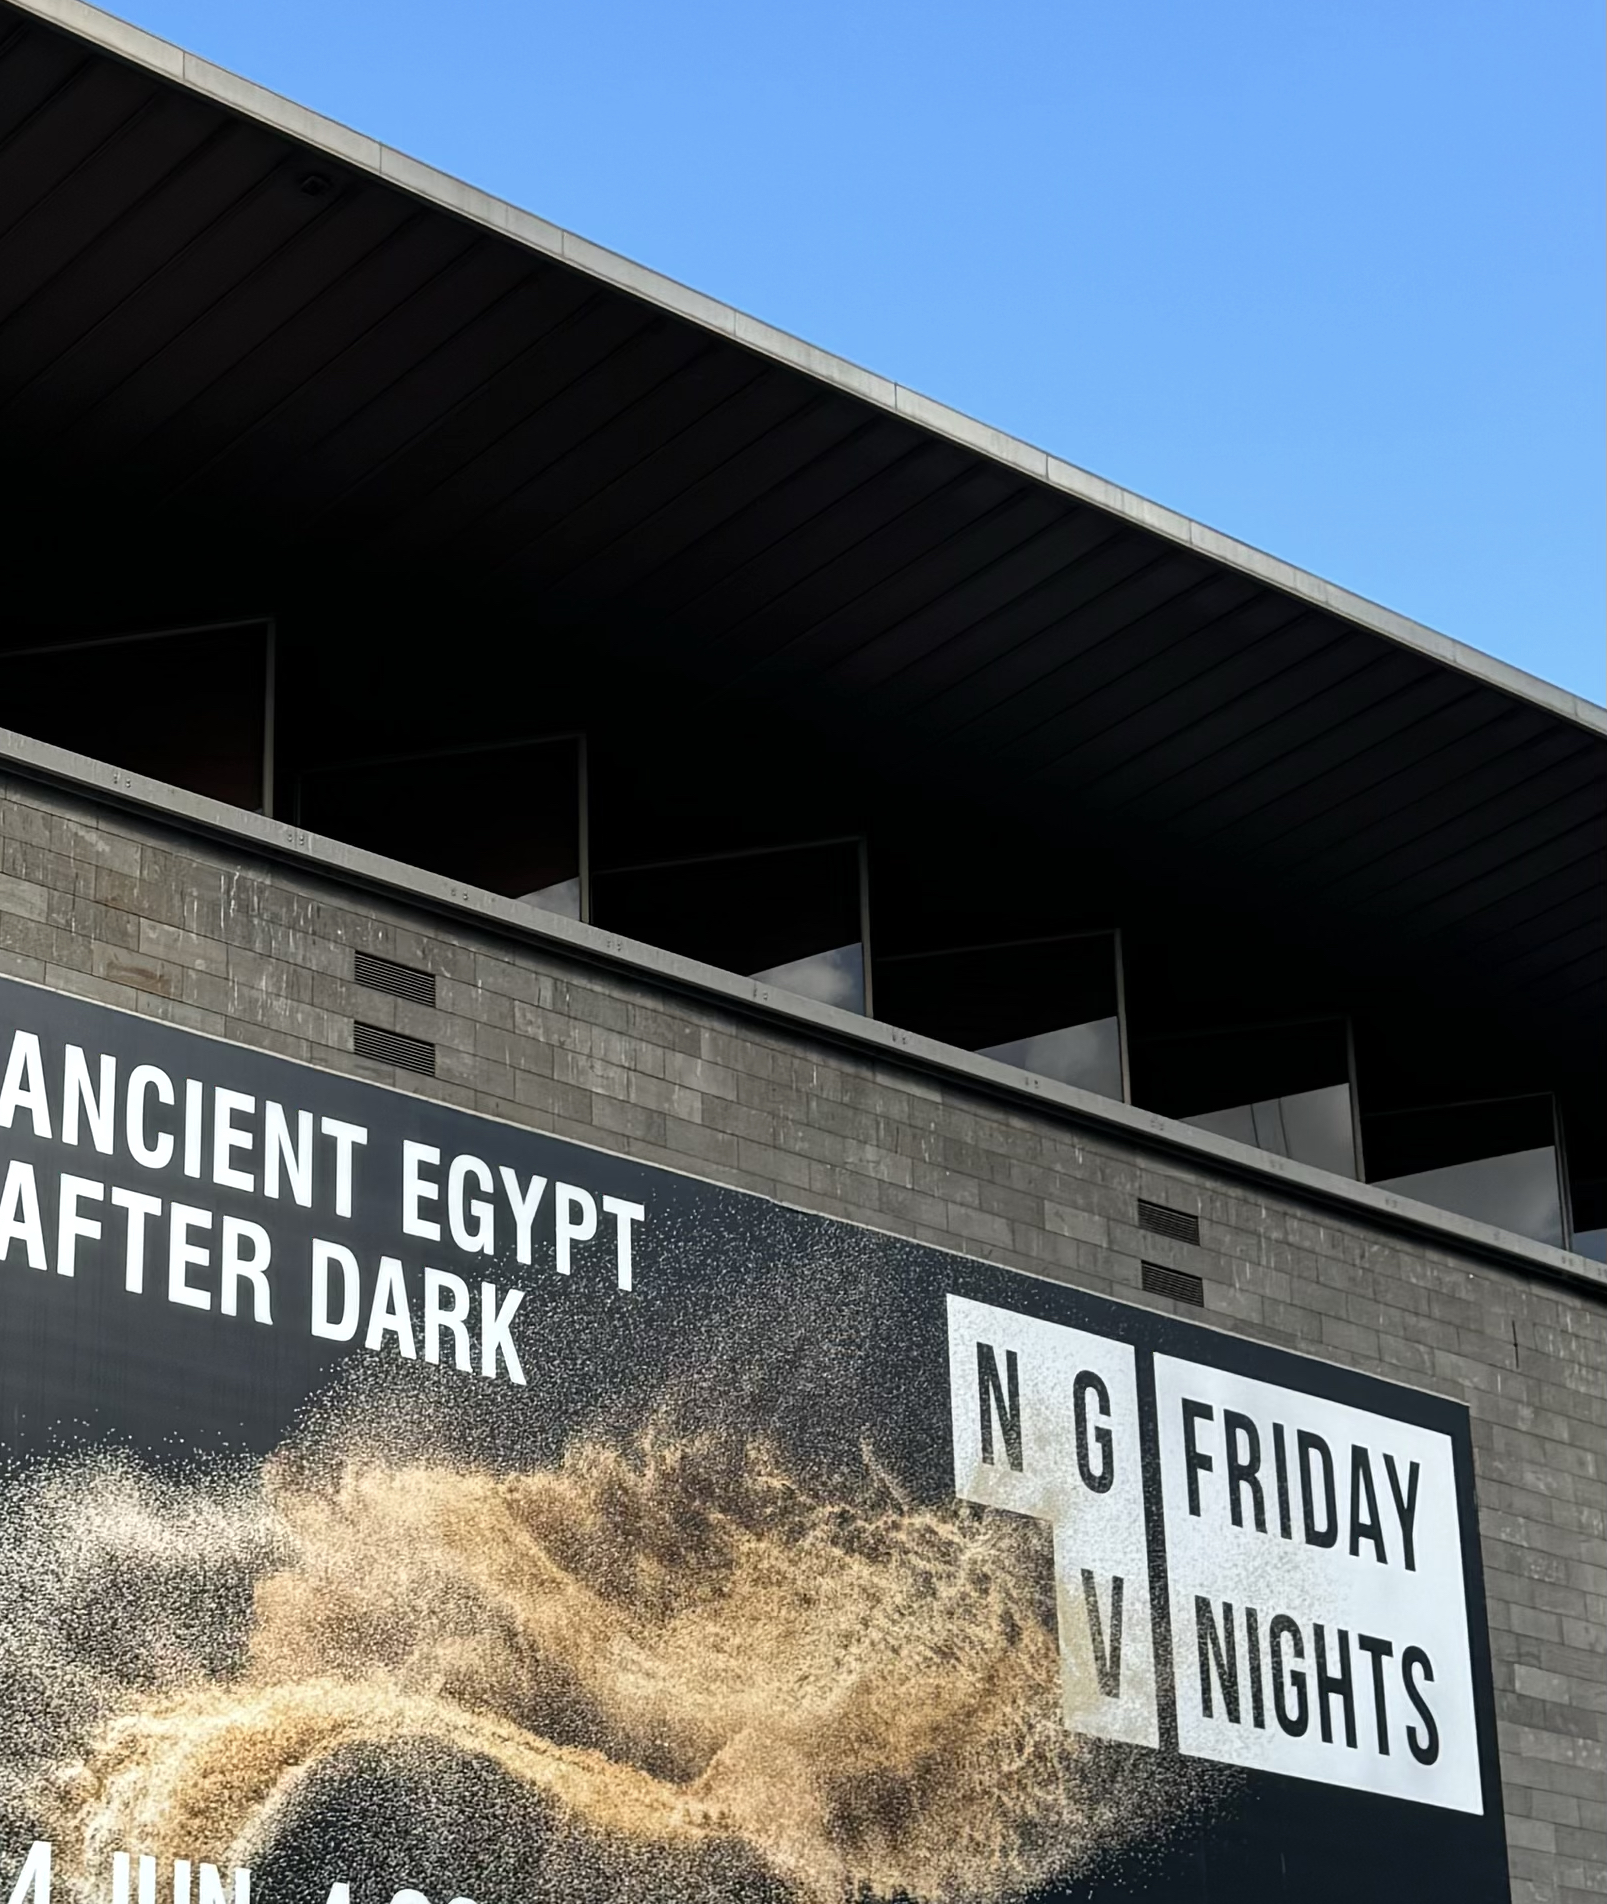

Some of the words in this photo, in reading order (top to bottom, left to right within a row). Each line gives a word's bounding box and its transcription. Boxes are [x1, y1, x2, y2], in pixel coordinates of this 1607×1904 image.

[402, 1139, 647, 1293] EGYPT
[310, 1238, 528, 1387] DARK
[976, 1341, 1024, 1473] N
[1072, 1369, 1115, 1494] G
[1181, 1397, 1420, 1572] FRIDAY
[1080, 1568, 1125, 1699] V
[1194, 1594, 1440, 1767] NIGHTS
